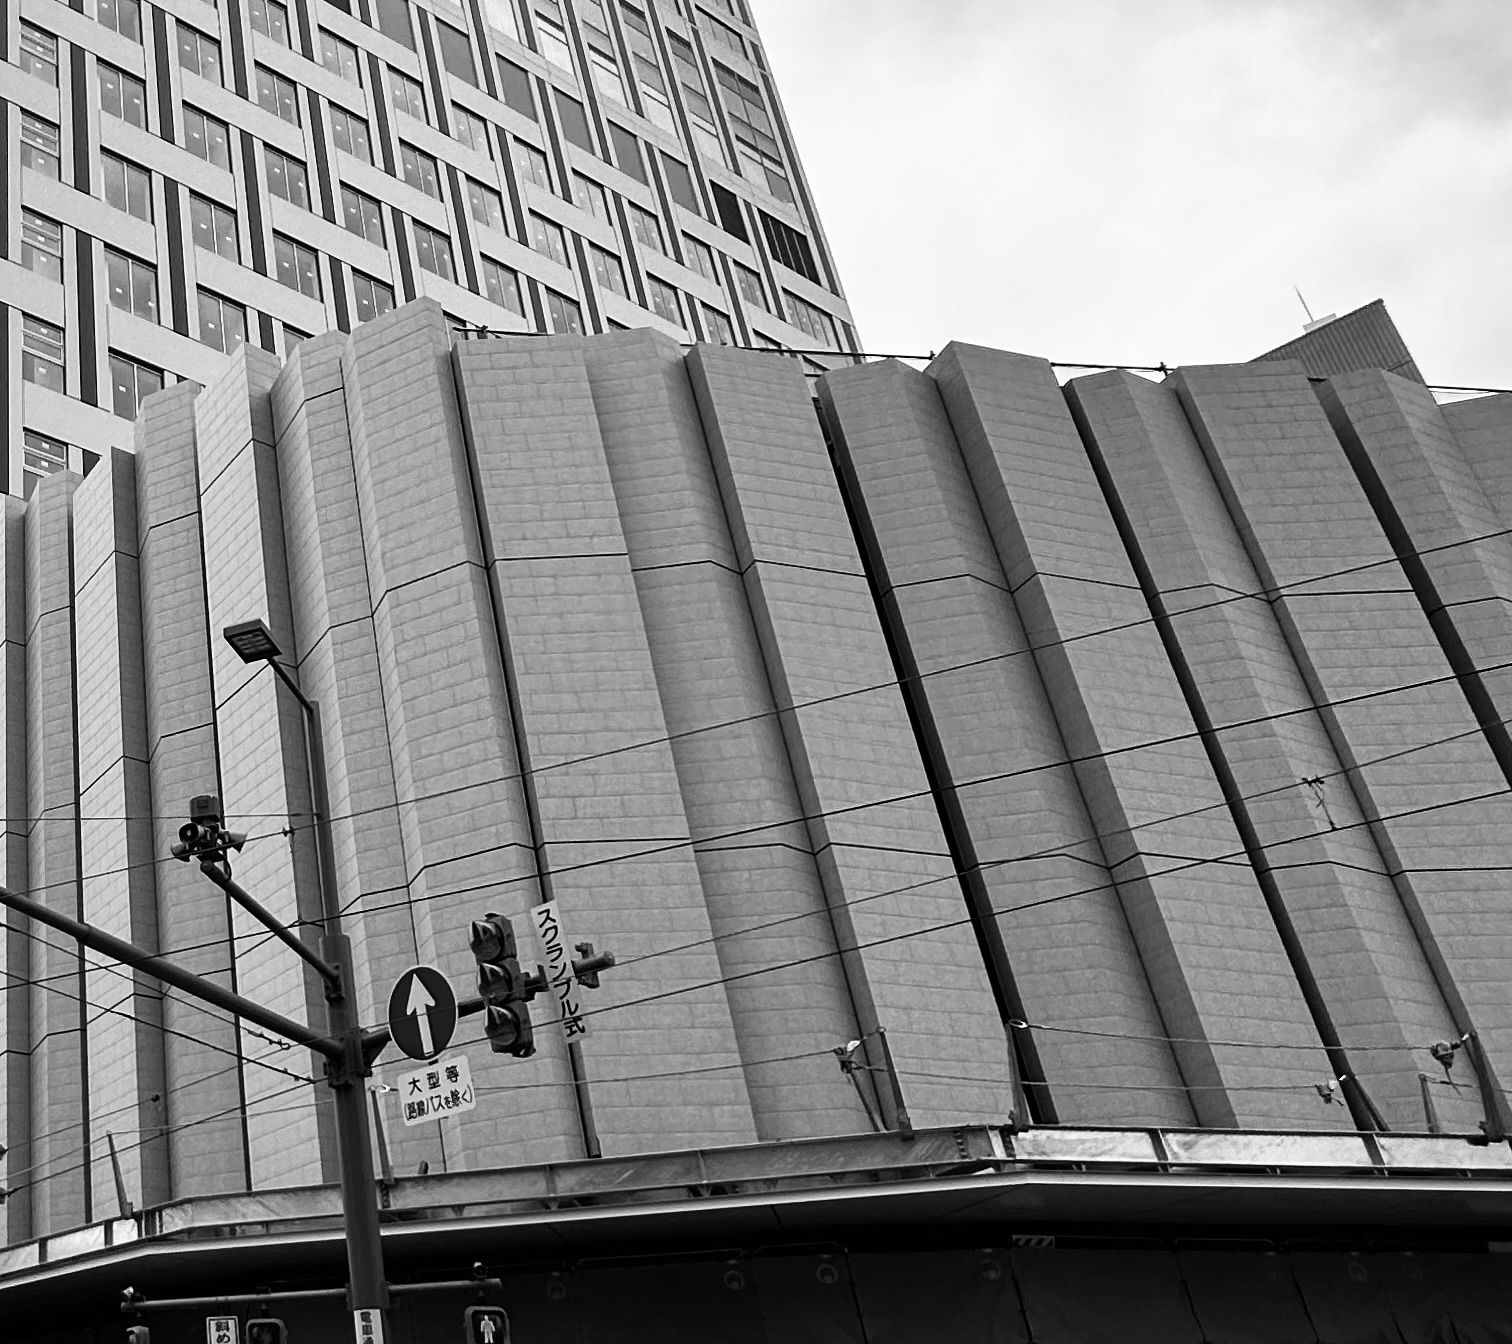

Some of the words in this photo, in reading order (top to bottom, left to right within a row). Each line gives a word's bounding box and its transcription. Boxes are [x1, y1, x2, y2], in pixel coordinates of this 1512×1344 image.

[537, 908, 586, 1038] スクランブル式
[408, 1064, 460, 1096] 大型等
